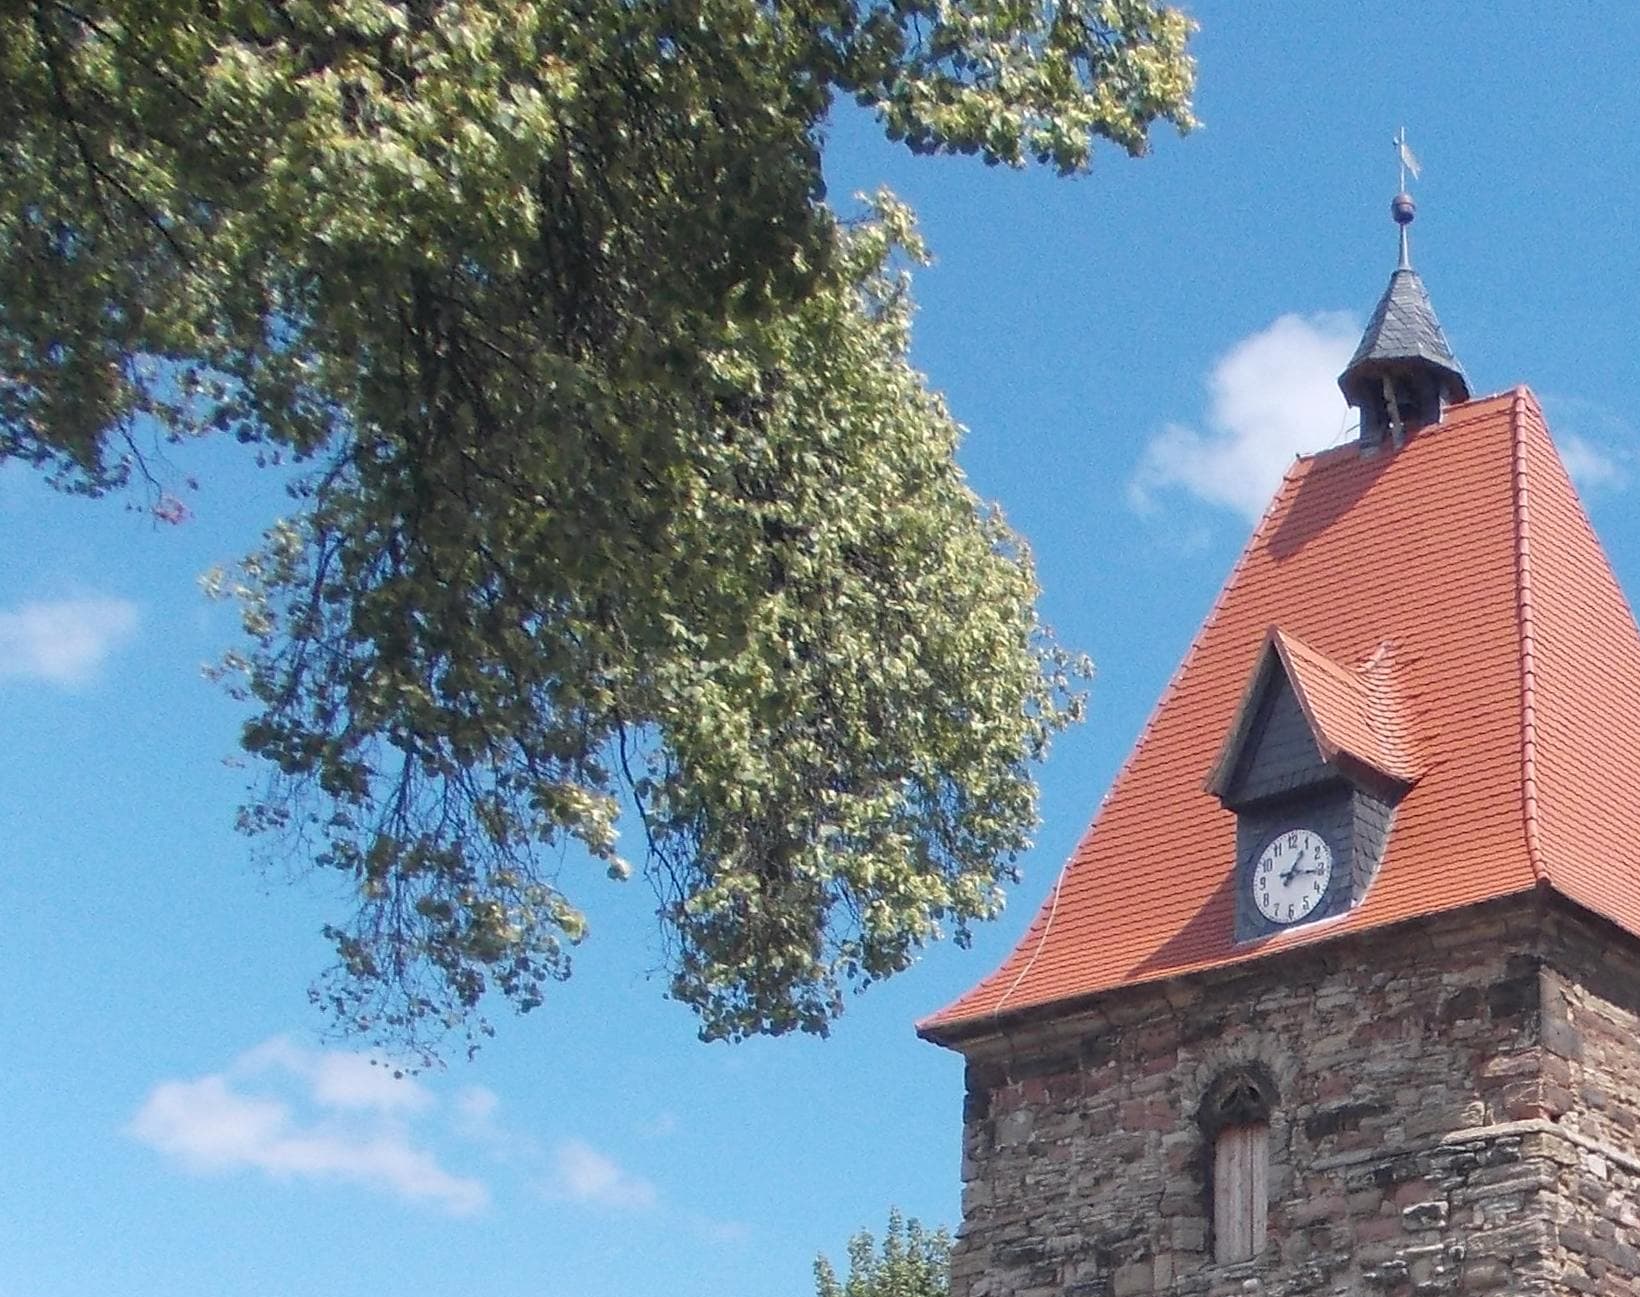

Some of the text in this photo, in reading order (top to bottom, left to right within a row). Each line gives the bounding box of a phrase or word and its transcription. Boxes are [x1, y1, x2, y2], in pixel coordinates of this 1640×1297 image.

[1288, 834, 1298, 849] 12
[1273, 843, 1282, 858] 11
[1314, 846, 1321, 860] 2
[1263, 858, 1273, 873] 10
[1260, 877, 1266, 891] 9
[1314, 880, 1320, 893] 4
[1263, 893, 1270, 908] 8
[1302, 896, 1310, 911] 5
[1274, 903, 1280, 917] 7
[1288, 904, 1294, 921] 6
